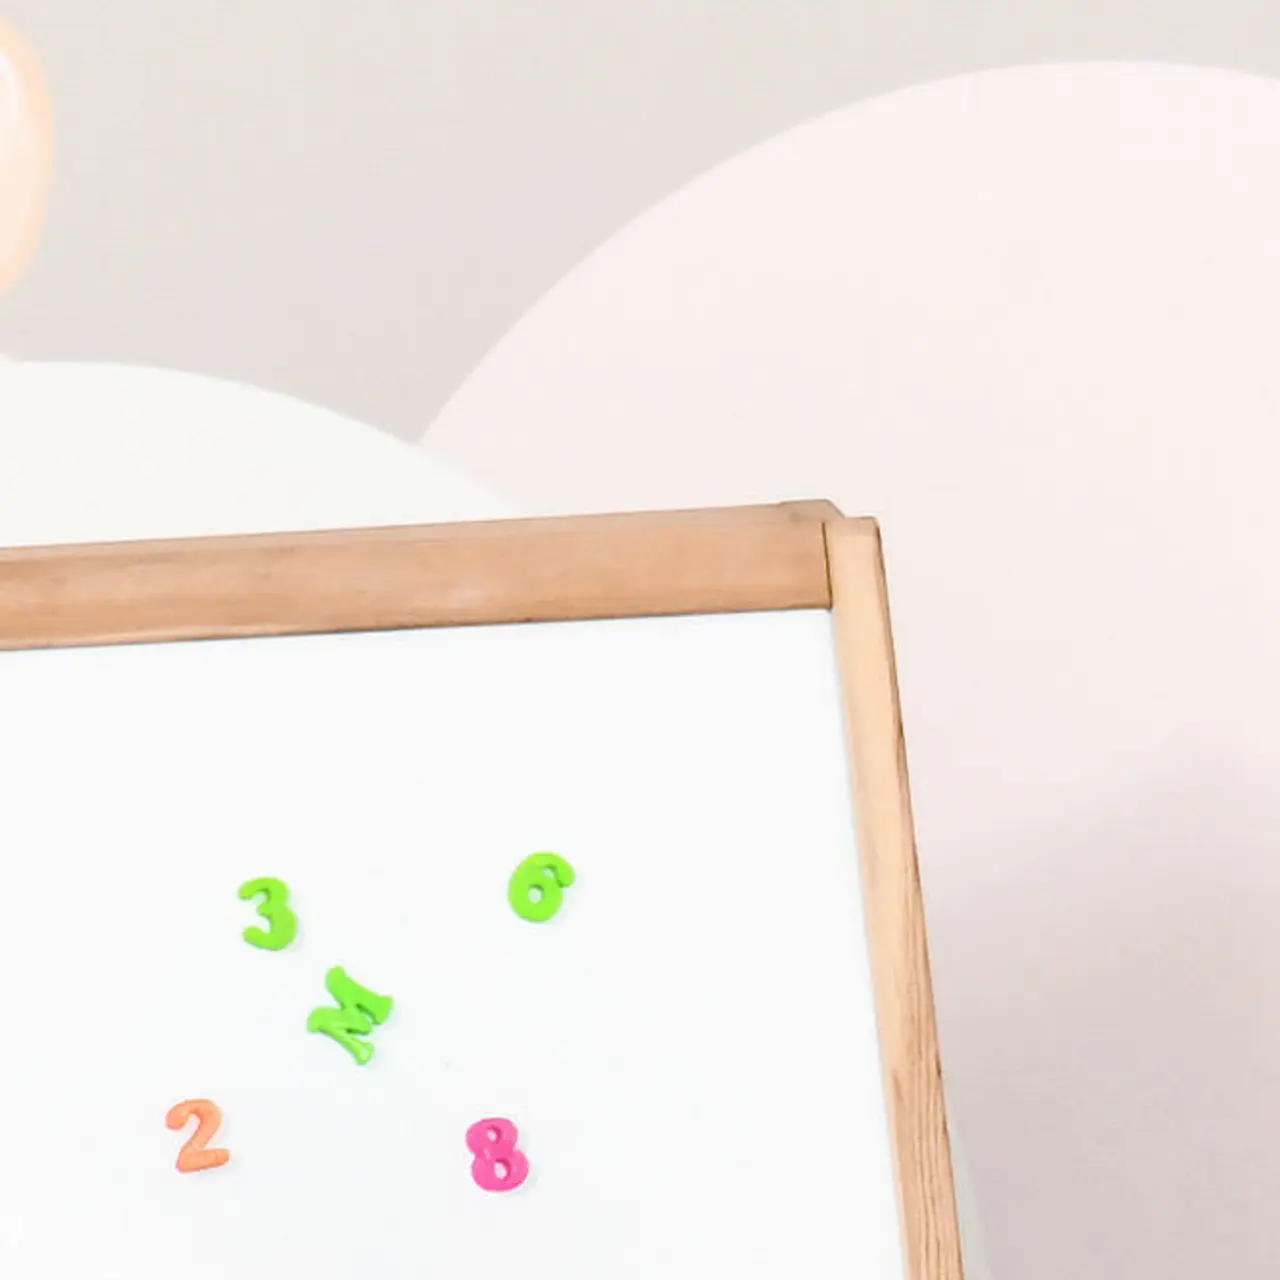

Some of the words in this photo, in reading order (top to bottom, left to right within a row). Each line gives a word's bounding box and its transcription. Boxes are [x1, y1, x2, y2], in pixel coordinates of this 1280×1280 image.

[237, 876, 297, 951] 3
[507, 850, 575, 923] 6
[165, 1098, 231, 1173] 2
[465, 1117, 530, 1193] 8
